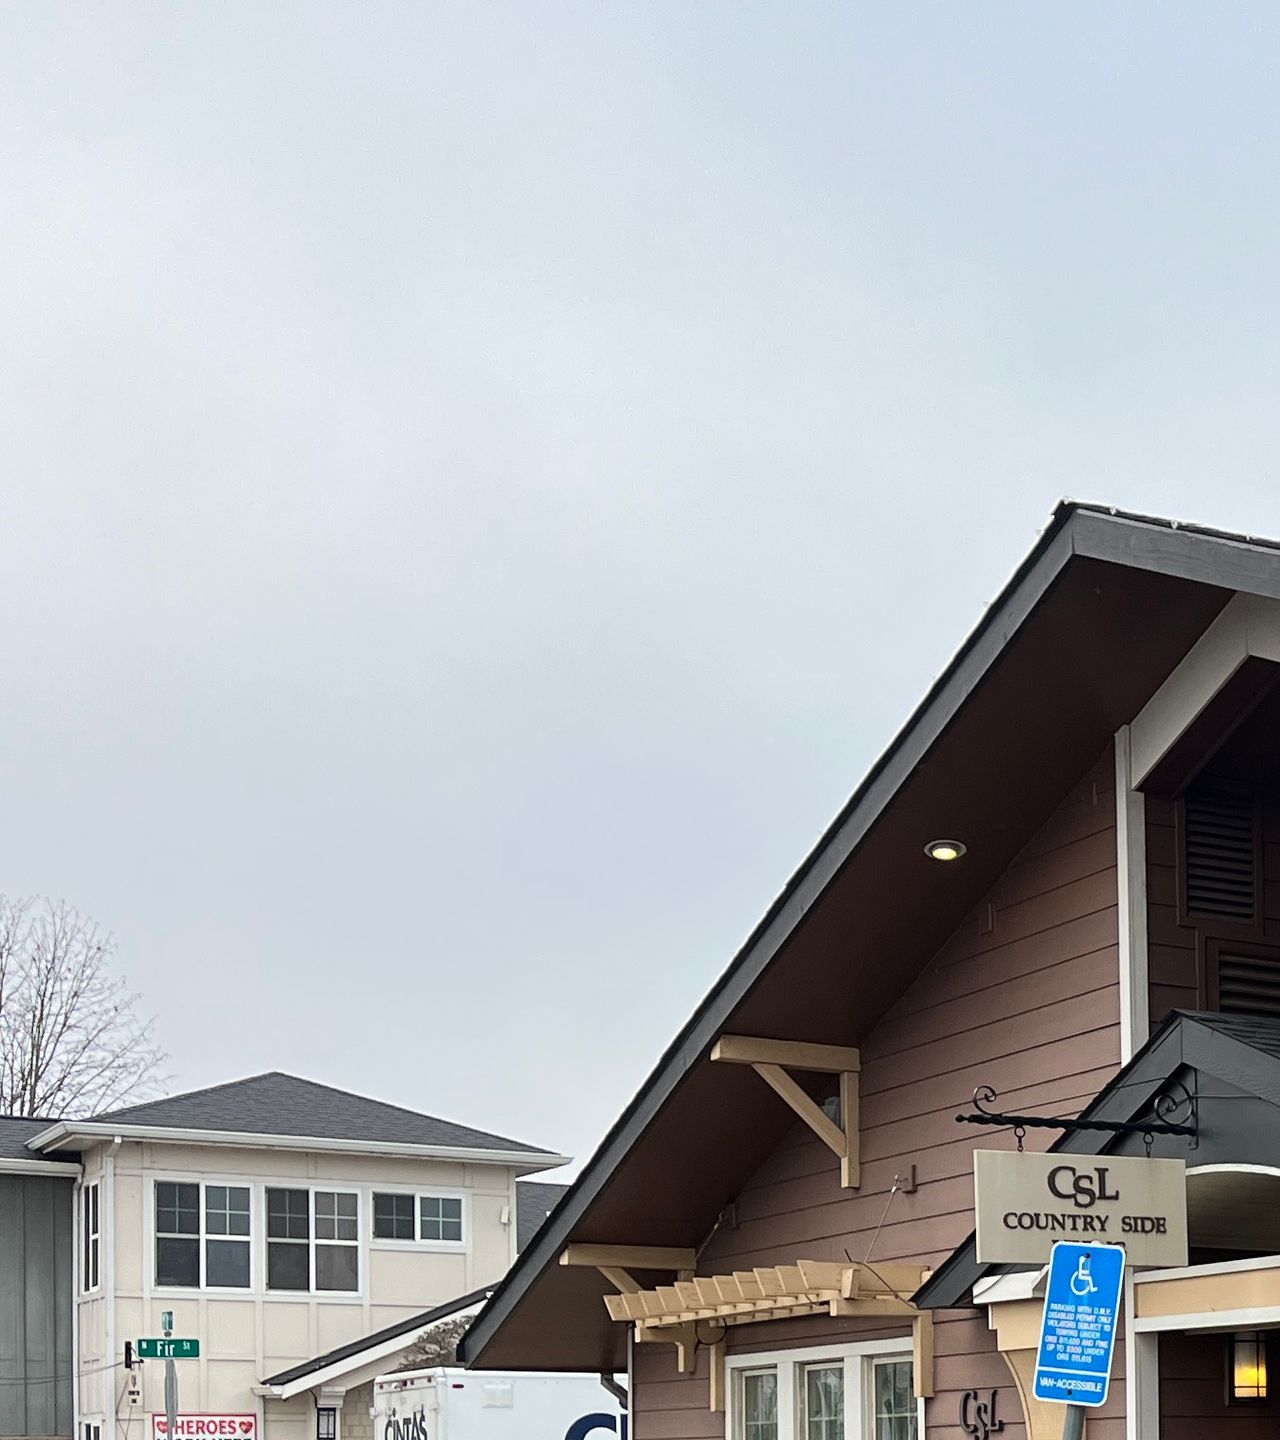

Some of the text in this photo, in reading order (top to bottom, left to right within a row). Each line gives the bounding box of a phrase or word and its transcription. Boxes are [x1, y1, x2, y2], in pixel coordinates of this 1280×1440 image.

[1048, 1166, 1119, 1208] CSL
[1003, 1212, 1167, 1234] COUNTRY SIDE
[157, 1341, 175, 1356] Fir
[1040, 1377, 1103, 1392] VAN-ACCESSIBLE
[175, 1421, 237, 1434] HEROES
